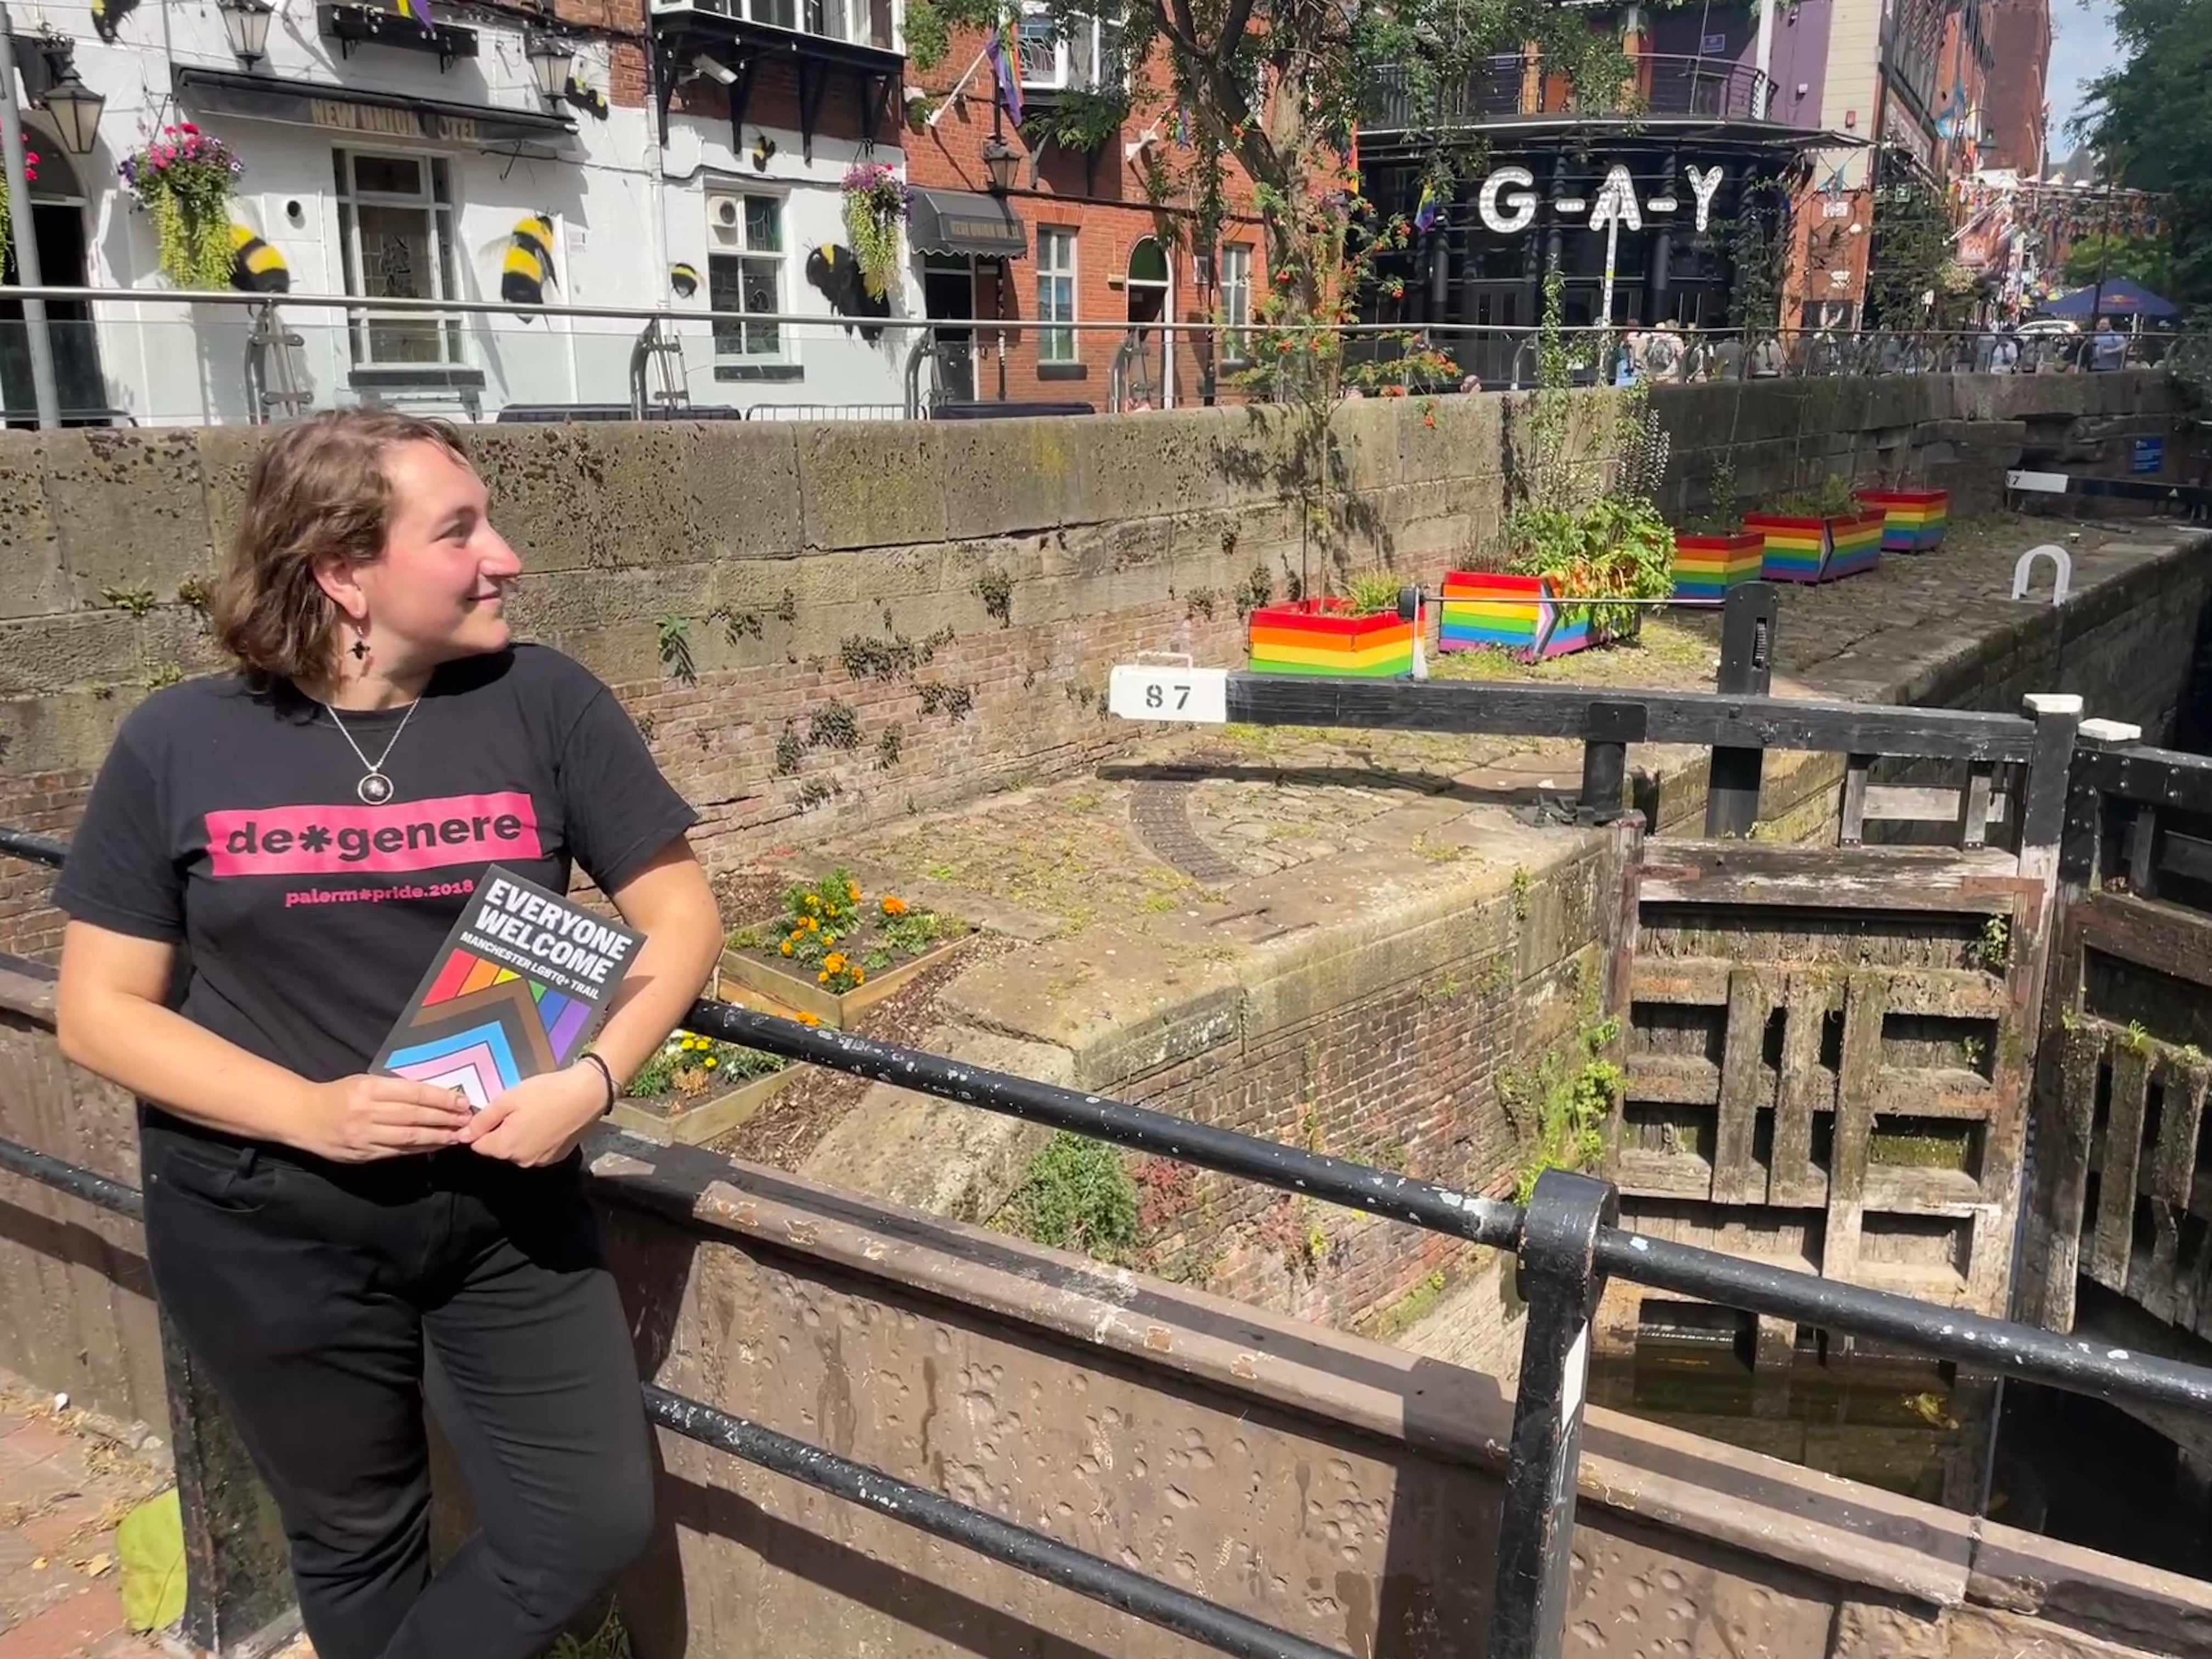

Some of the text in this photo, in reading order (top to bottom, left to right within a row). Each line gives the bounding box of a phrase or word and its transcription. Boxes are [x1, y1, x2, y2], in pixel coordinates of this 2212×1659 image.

[311, 98, 356, 128] NEW
[1479, 163, 1724, 233] G-A-Y
[1146, 685, 1191, 710] 87
[475, 905, 614, 984] WELCOME
[485, 878, 633, 961] EVERYONE
[460, 932, 600, 1000] MANCHESTER LGBTQ+ TRAIL
